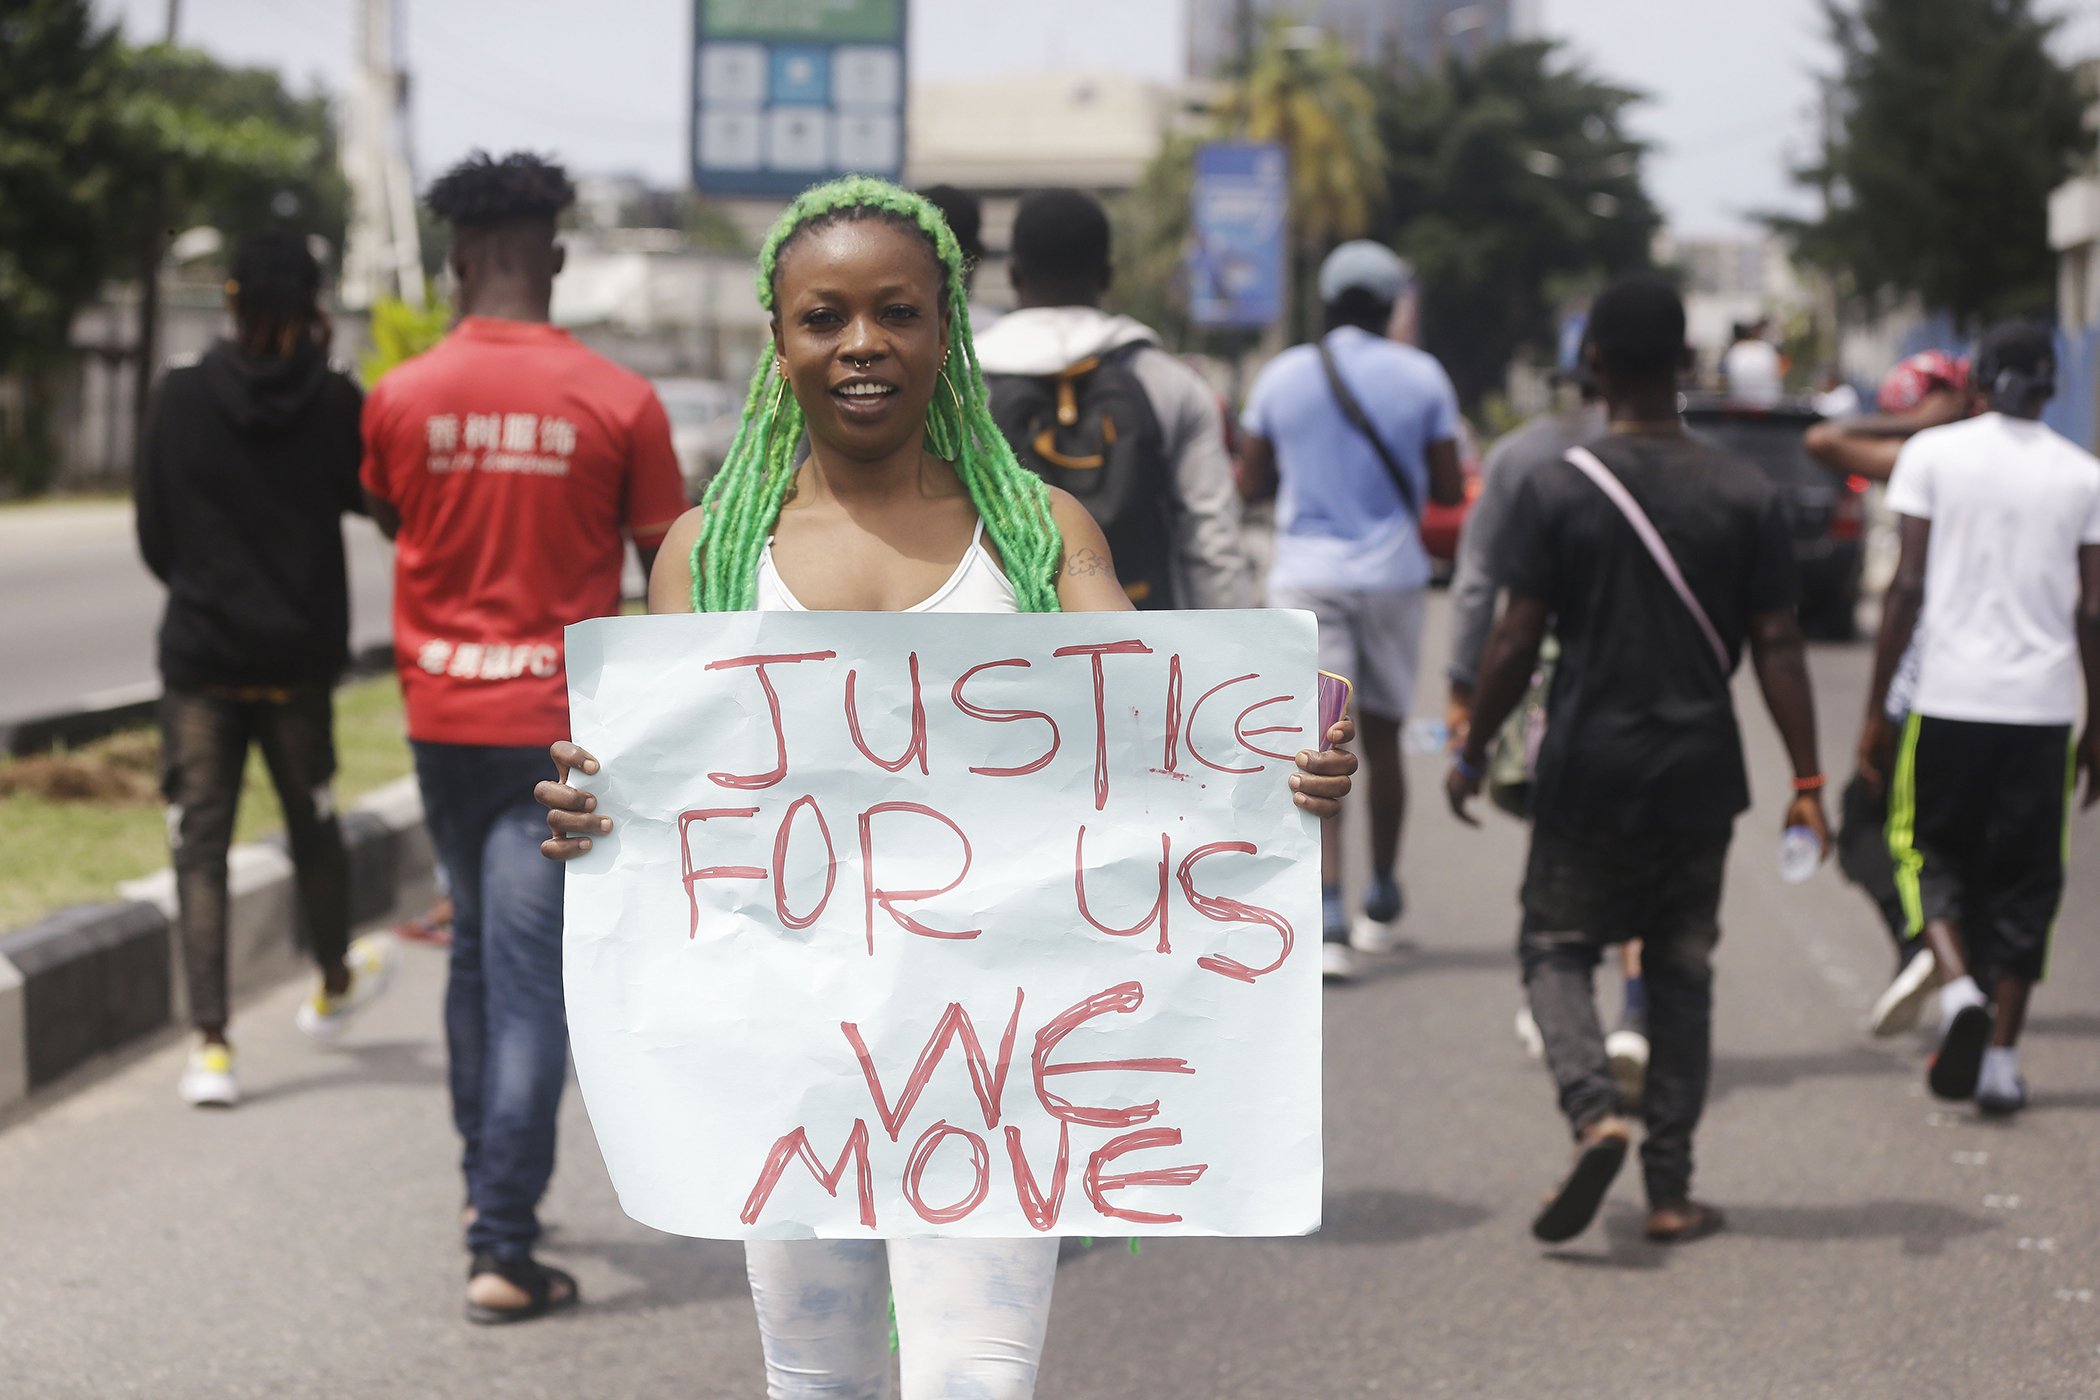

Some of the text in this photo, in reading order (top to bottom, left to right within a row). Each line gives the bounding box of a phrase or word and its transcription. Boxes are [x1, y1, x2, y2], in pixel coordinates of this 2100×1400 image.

[704, 639, 1304, 810] JUSTICE
[680, 795, 1295, 983] FOR US
[840, 981, 1196, 1142] WE
[740, 1117, 1208, 1231] MOVE
